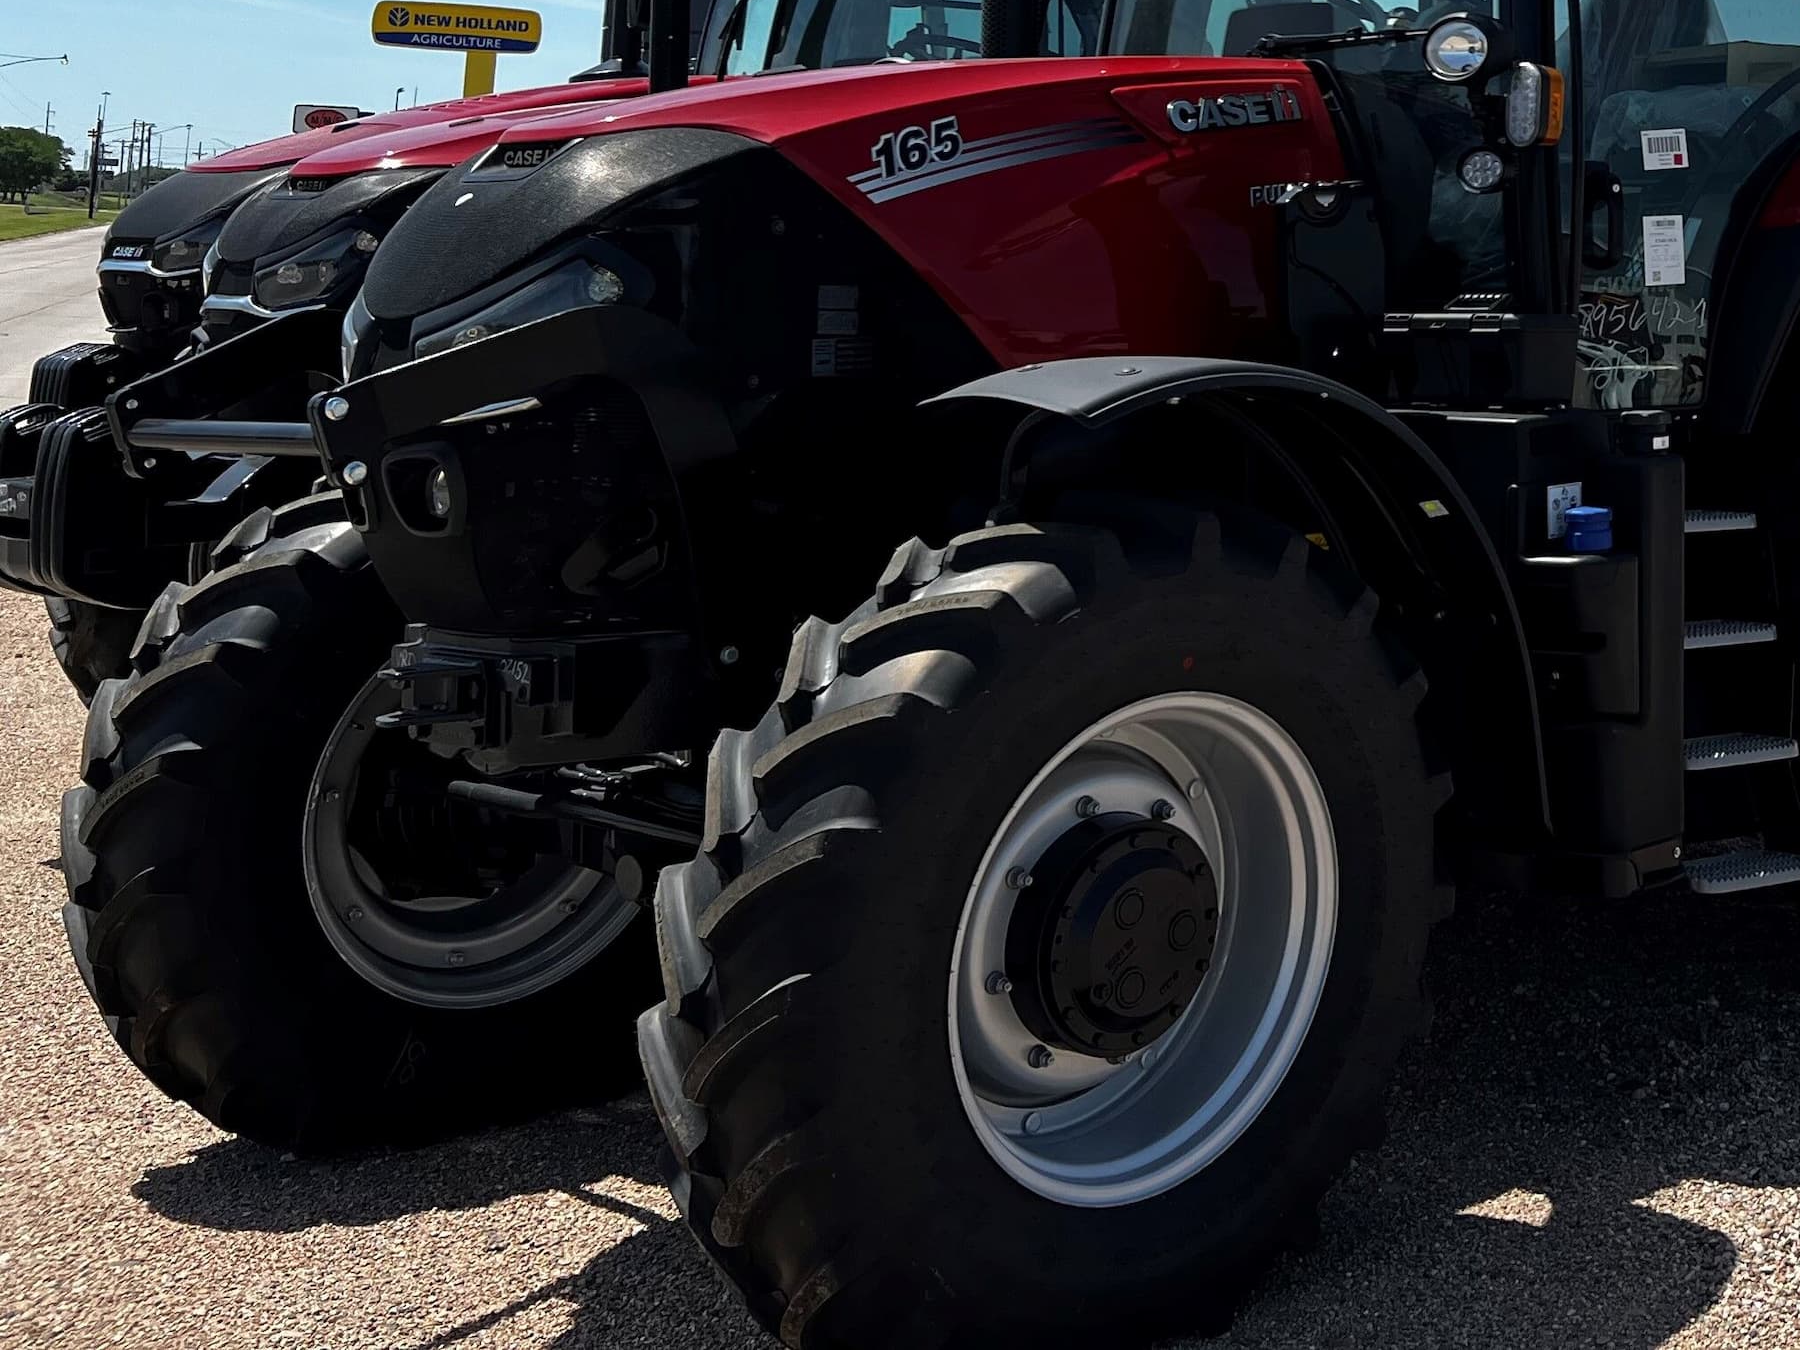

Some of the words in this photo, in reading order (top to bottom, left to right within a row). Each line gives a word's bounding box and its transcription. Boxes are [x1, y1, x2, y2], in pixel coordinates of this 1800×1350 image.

[414, 13, 452, 28] NEW
[455, 15, 529, 33] HOLLAND
[411, 33, 502, 49] AGRICULTURE
[1166, 92, 1270, 133] CASE
[504, 149, 543, 166] CASE
[871, 115, 963, 182] 165
[112, 246, 135, 258] CASE
